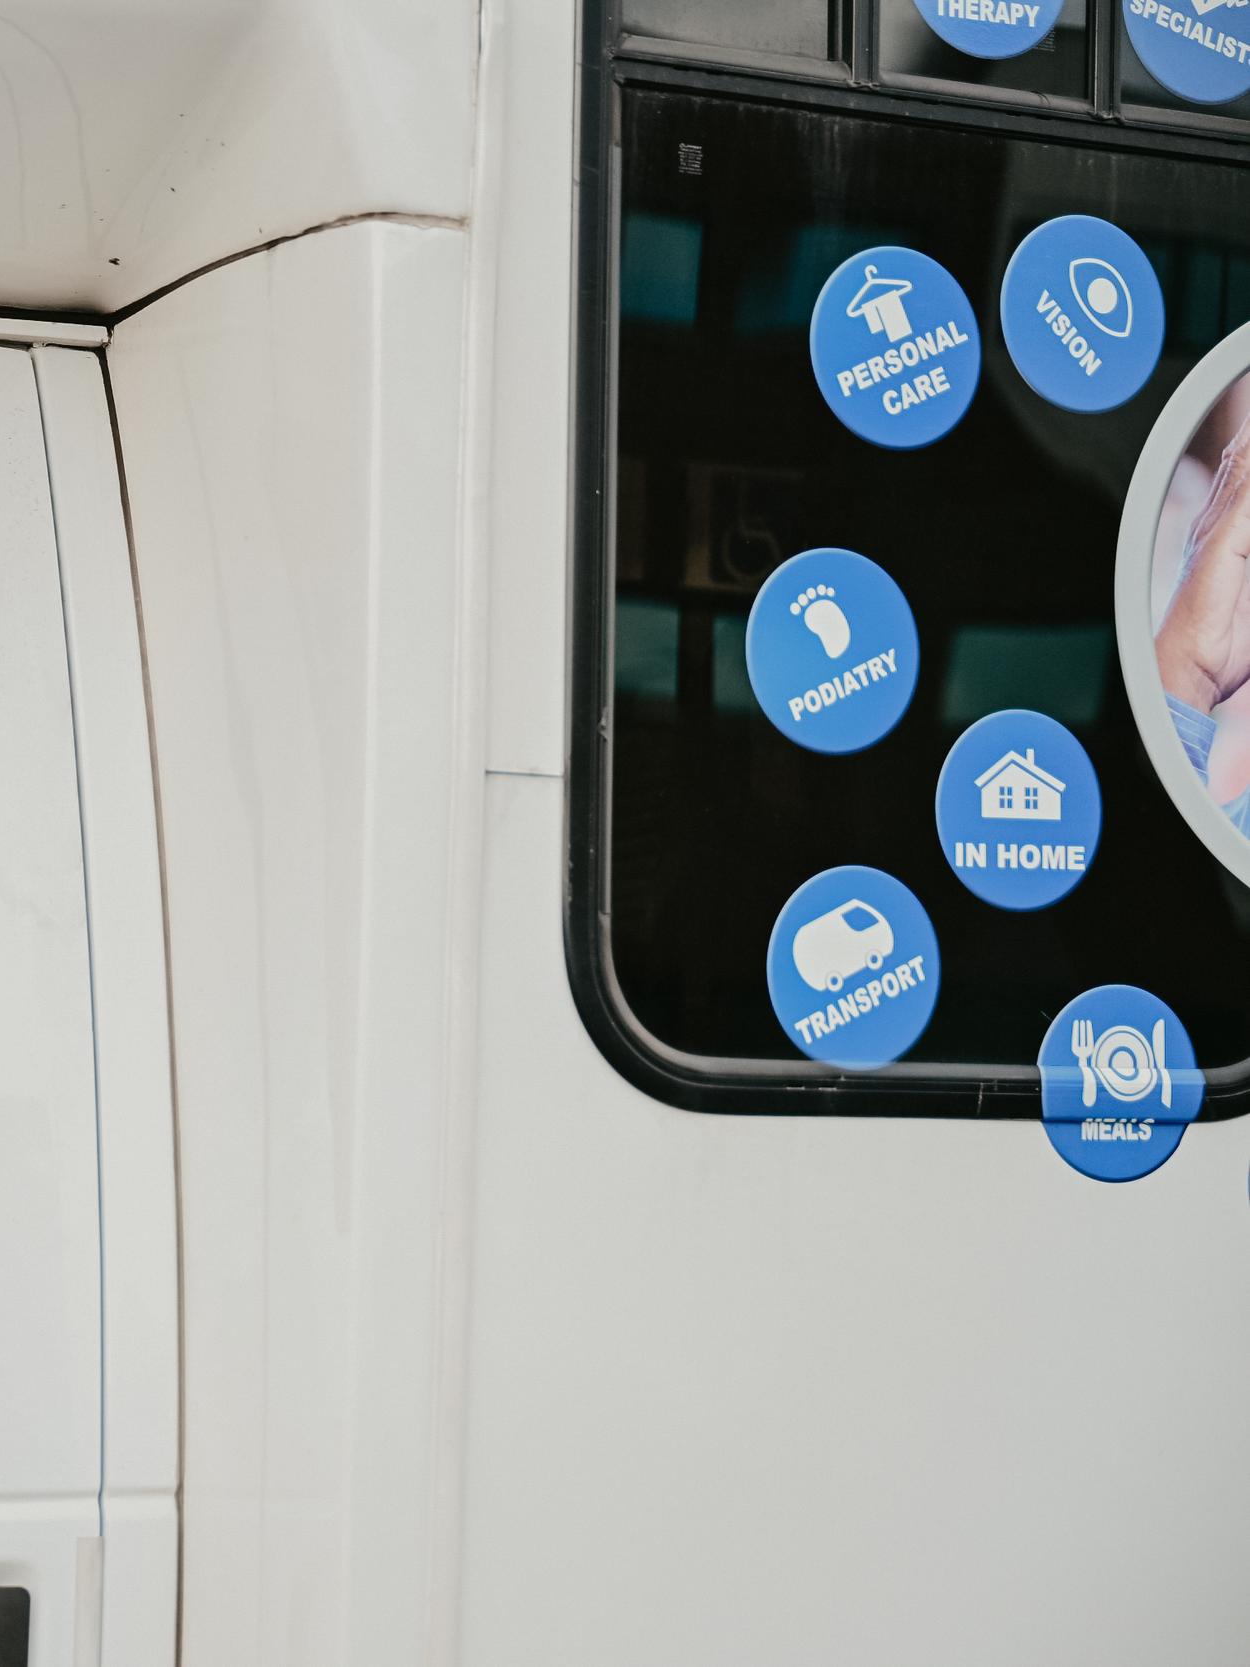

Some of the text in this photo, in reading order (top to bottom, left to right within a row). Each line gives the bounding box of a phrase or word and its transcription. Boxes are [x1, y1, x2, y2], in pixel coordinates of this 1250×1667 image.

[1130, 0, 1250, 66] SPECIALIST
[837, 321, 969, 397] PERSONAL
[1036, 289, 1103, 377] VISION
[882, 366, 951, 416] CARE
[788, 648, 898, 722] PODIATRY
[955, 842, 1086, 871] IN HOME
[794, 955, 927, 1044] TRANSPORT
[1081, 1118, 1155, 1141] MEALS
